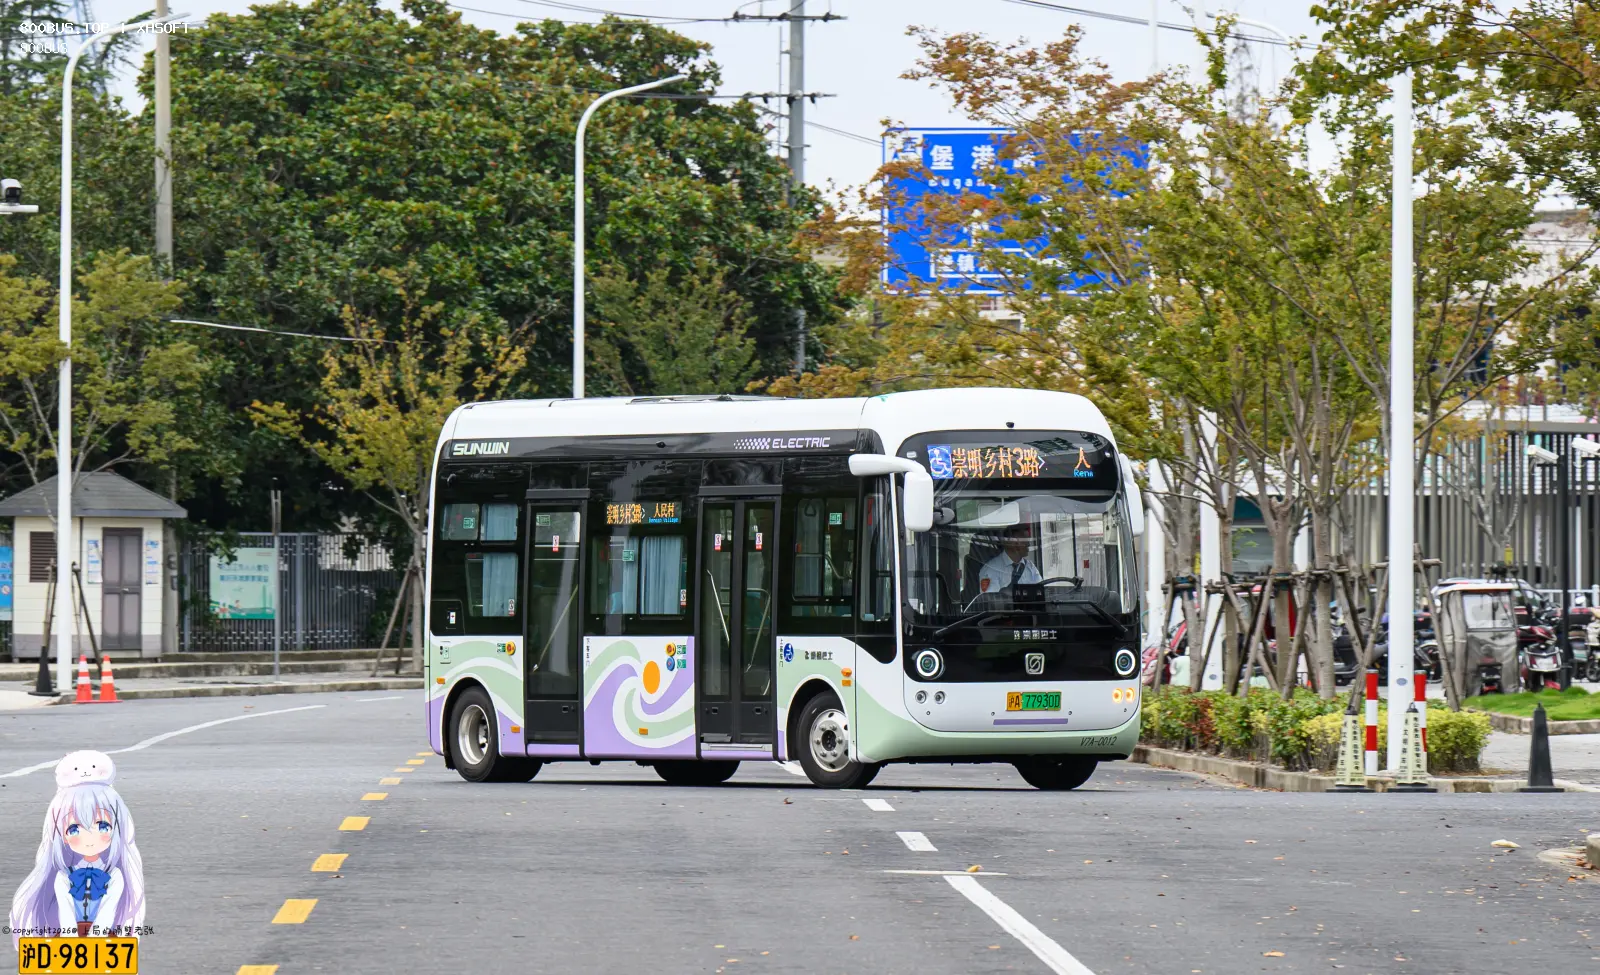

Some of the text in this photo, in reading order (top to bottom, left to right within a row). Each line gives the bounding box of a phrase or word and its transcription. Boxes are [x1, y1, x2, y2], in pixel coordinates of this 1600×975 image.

[453, 441, 510, 456] SUNWIN
[772, 437, 831, 449] ELECTRIC
[952, 447, 1092, 478] 崇明乡村3路 人
[653, 502, 675, 518] 人民村
[1080, 737, 1118, 747] V7A-0012
